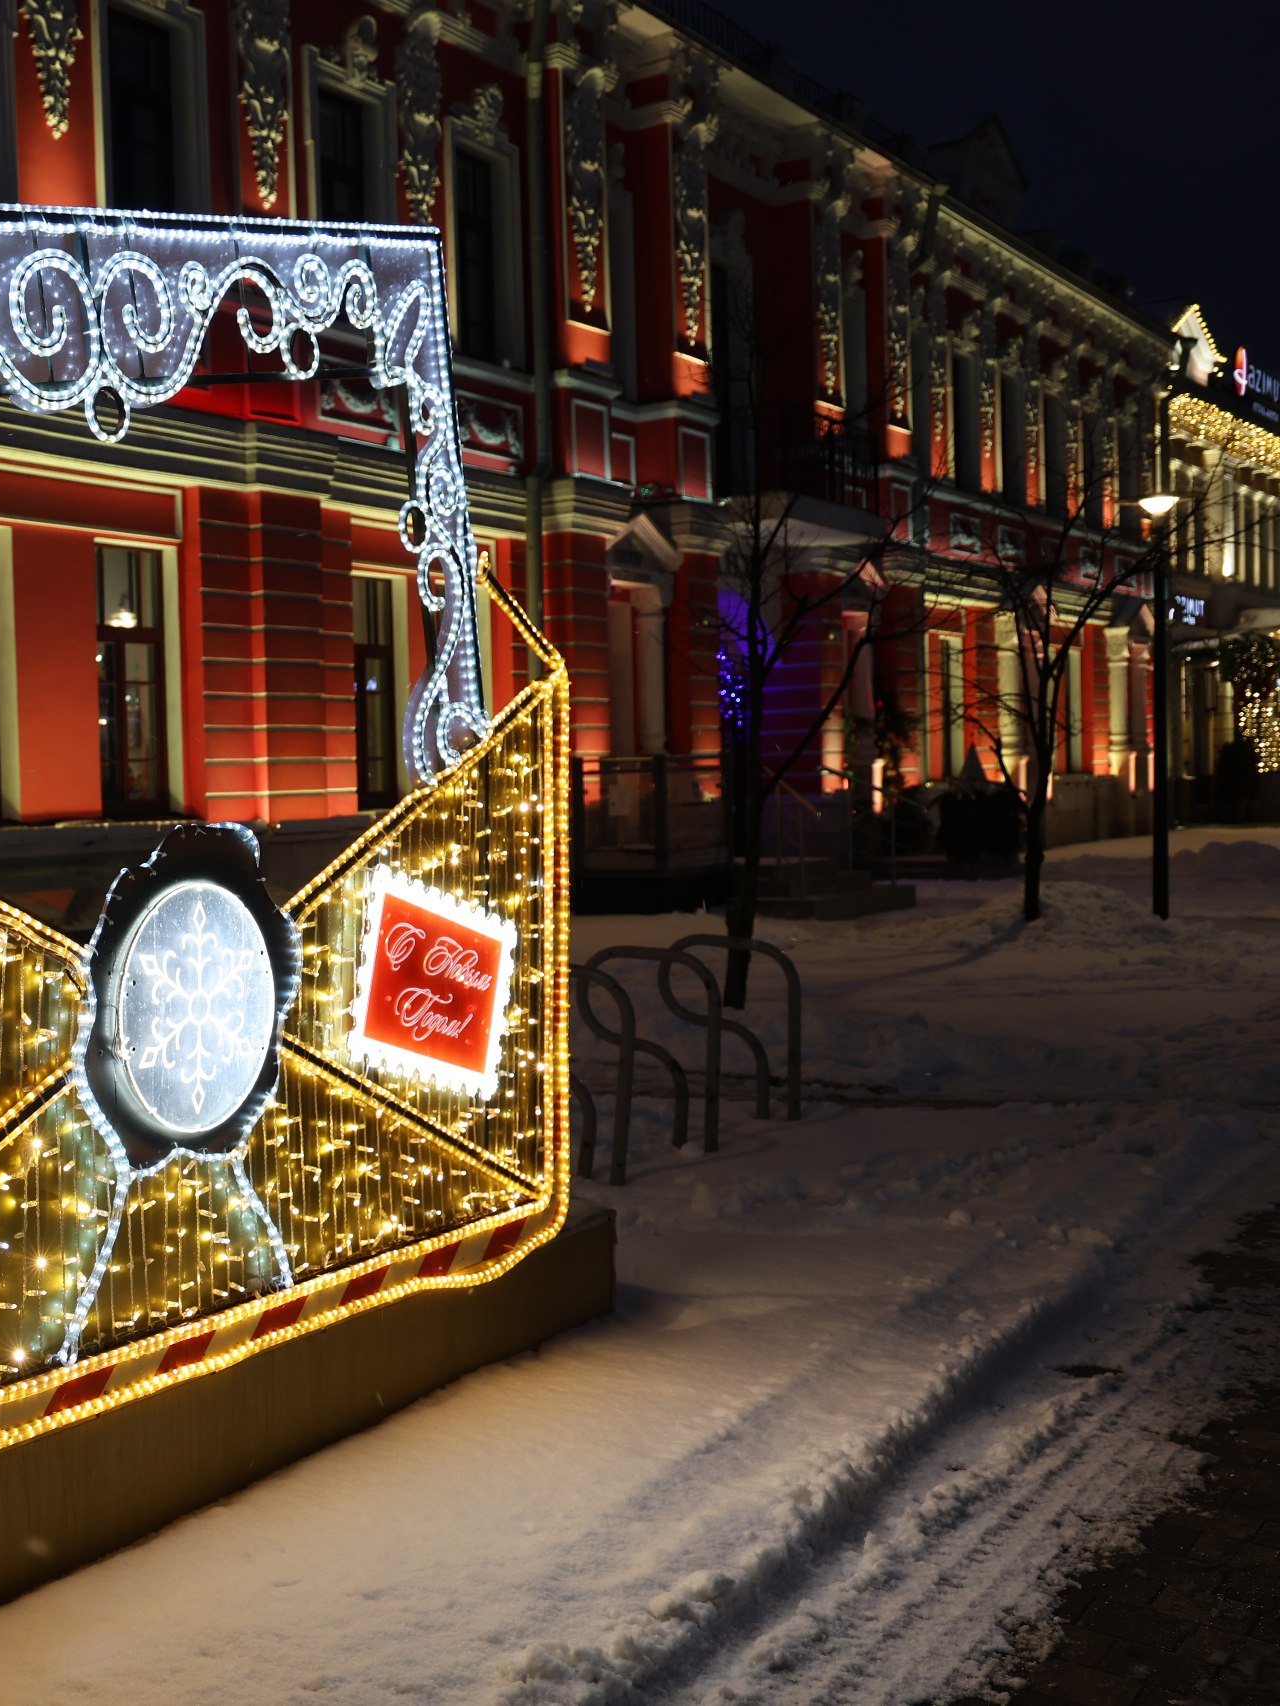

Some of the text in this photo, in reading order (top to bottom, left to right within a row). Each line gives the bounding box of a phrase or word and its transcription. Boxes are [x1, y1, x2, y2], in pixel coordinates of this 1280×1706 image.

[384, 922, 492, 991] С Новым
[395, 987, 474, 1041] Годом!
